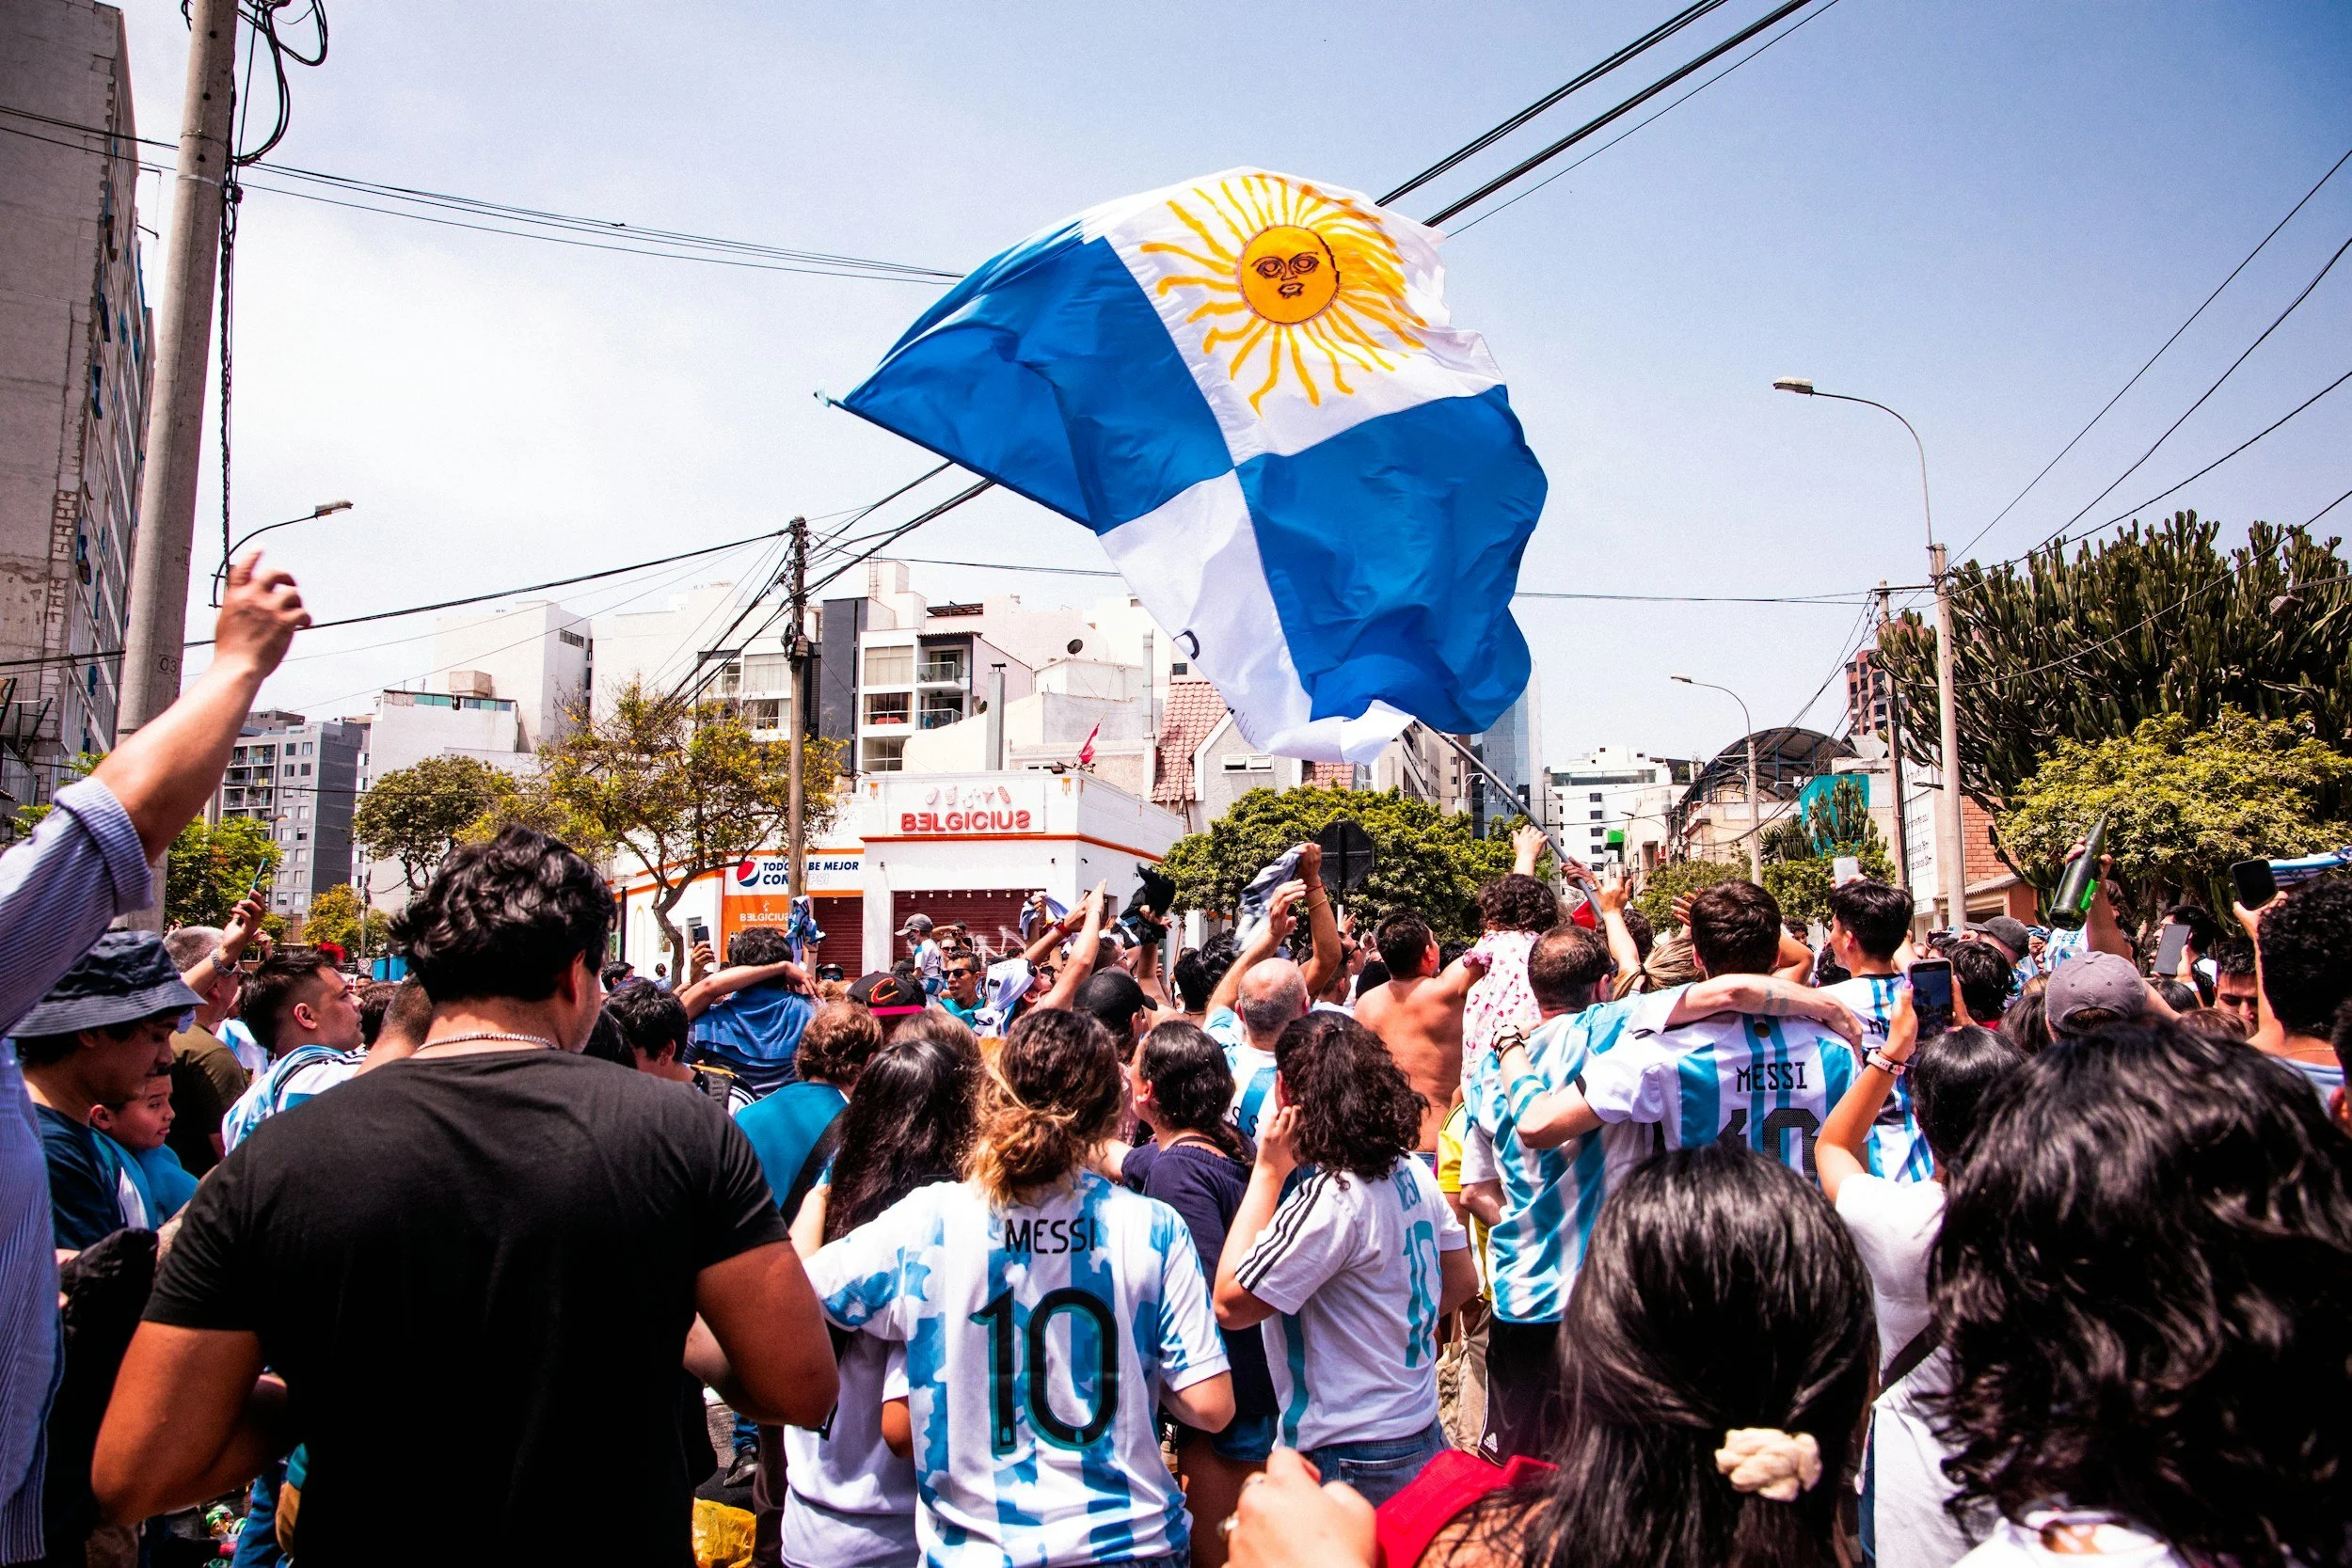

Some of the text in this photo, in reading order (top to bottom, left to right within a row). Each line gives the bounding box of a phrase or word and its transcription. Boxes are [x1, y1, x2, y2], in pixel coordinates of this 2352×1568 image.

[901, 810, 1030, 832] BELGICIUS
[823, 862, 859, 871] MEJOR
[1736, 1061, 1807, 1092] MESSI
[1005, 1217, 1096, 1254] MESSI
[969, 1286, 1120, 1455] 10
